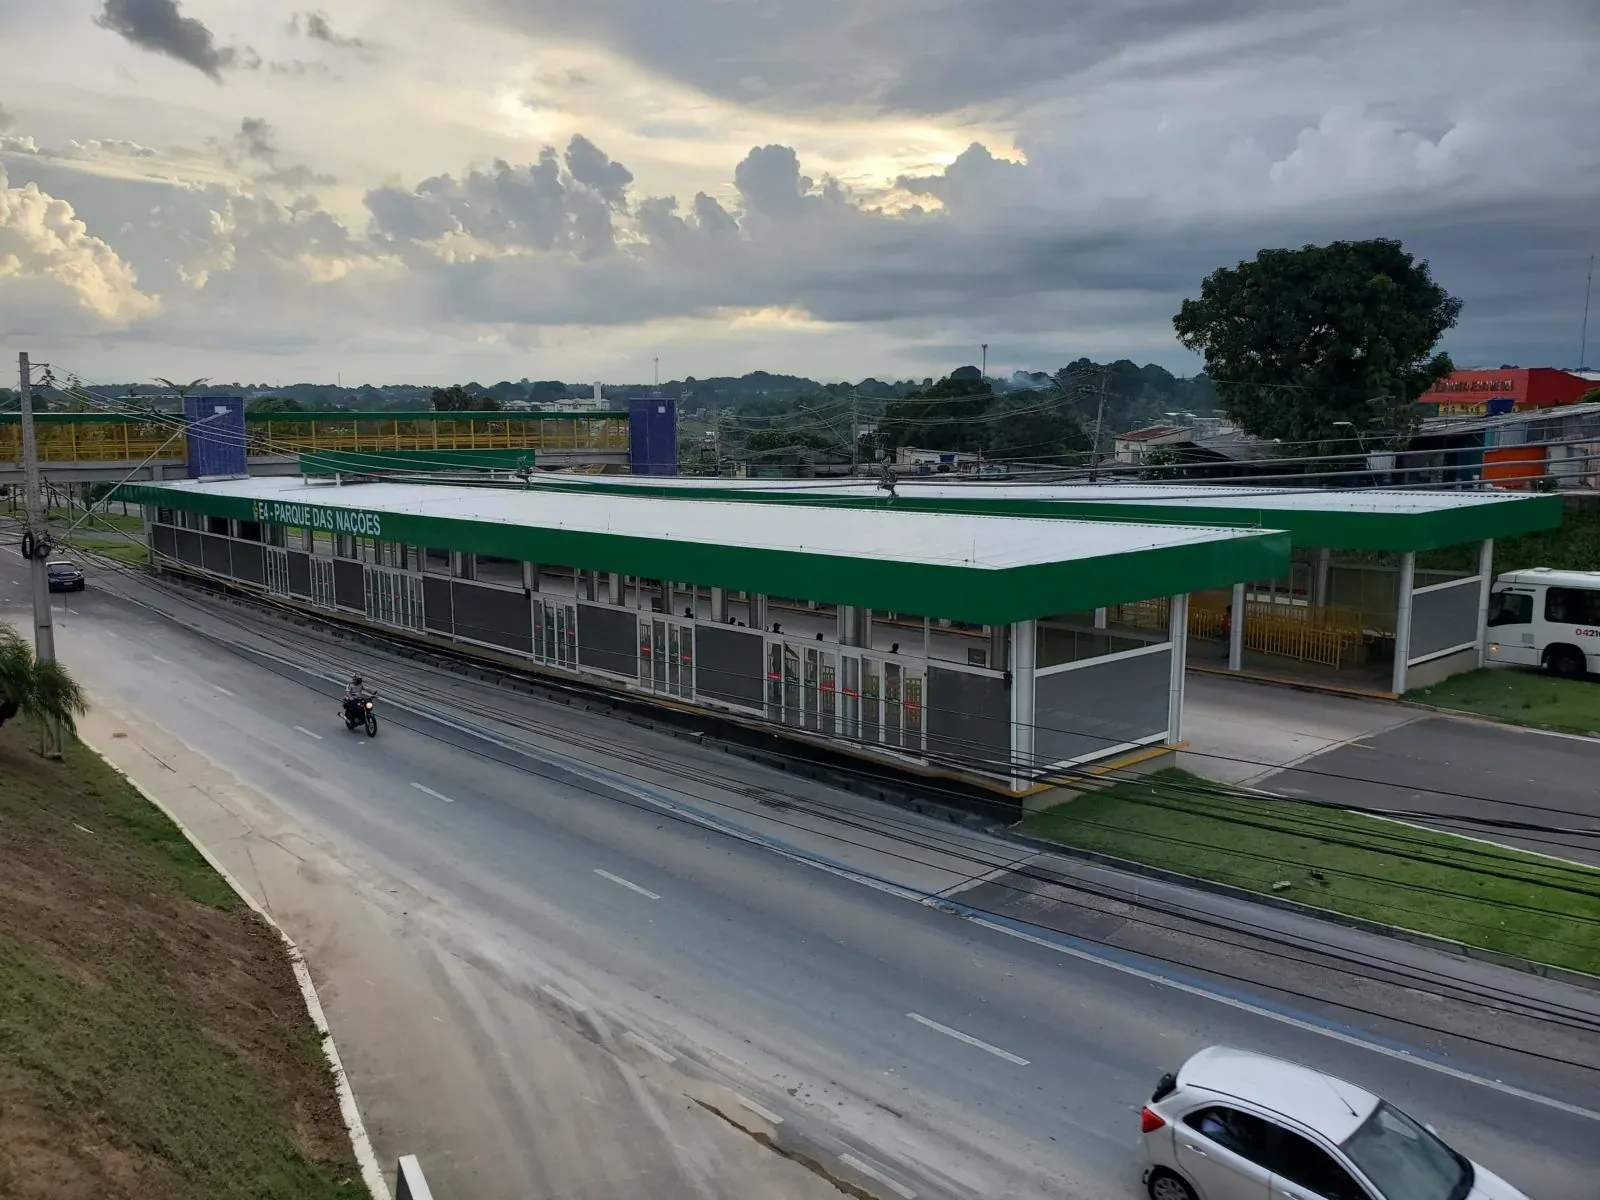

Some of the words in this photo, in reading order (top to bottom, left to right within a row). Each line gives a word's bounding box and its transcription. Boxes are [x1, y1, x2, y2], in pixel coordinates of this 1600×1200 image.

[258, 502, 268, 520] E4
[274, 503, 311, 526] PARQUE
[312, 508, 334, 529] DAS
[335, 509, 381, 536] NAÇÕES
[1576, 628, 1600, 637] 0421
